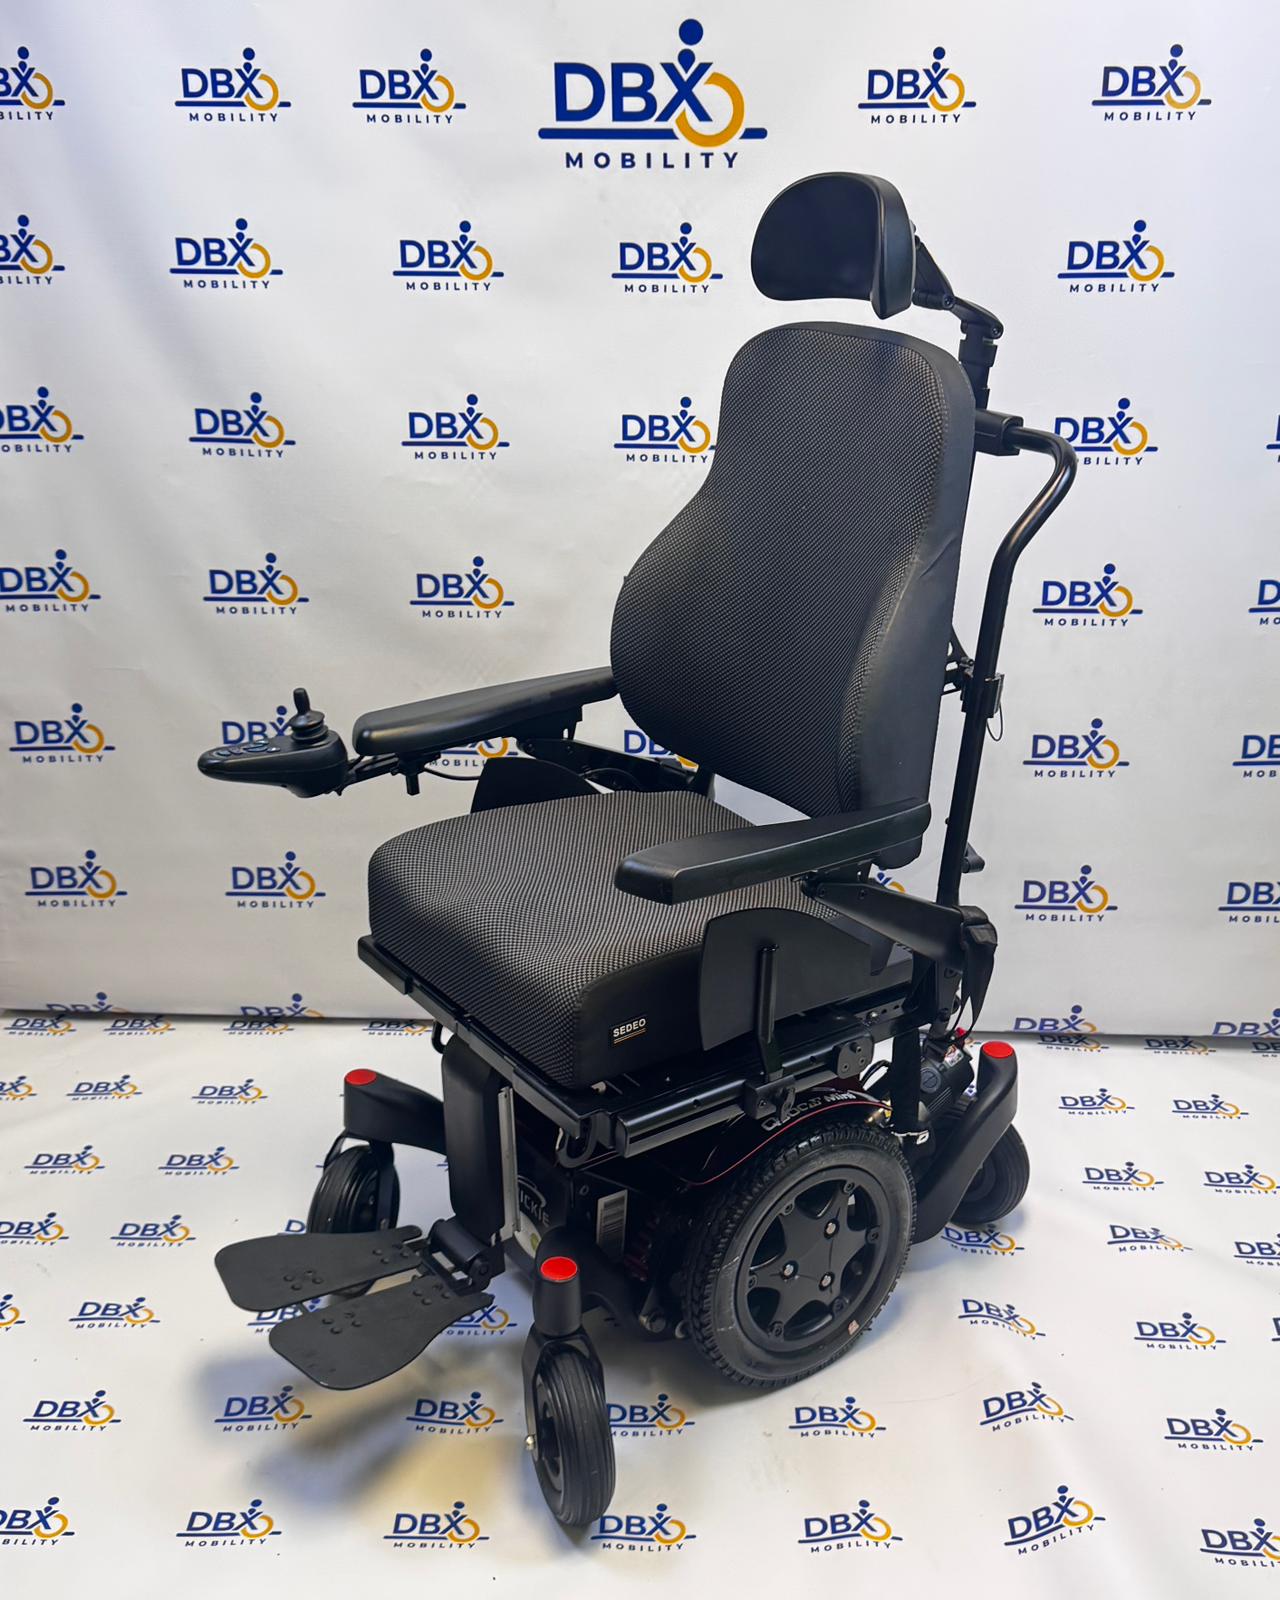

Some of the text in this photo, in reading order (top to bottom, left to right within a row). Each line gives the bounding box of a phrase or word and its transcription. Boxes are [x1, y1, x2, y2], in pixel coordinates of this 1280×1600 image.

[181, 68, 262, 98] DBX
[359, 69, 437, 99] DBX
[867, 69, 950, 99] DBX
[1101, 66, 1186, 96] DBX
[554, 62, 713, 122] DBX
[189, 112, 278, 122] MOBILITY
[366, 114, 453, 124] MOBILITY
[870, 113, 961, 124] MOBILITY
[1104, 111, 1196, 121] MOBILITY
[565, 152, 738, 169] MOBILITY
[175, 237, 255, 266] DBX
[400, 240, 477, 268] DBX
[620, 243, 697, 270] DBX
[1068, 241, 1149, 270] DBX
[183, 279, 270, 289] MOBILITY
[406, 282, 491, 291] MOBILITY
[624, 285, 709, 294] MOBILITY
[1070, 283, 1159, 293] MOBILITY
[195, 408, 272, 436] DBX
[408, 411, 484, 439] DBX
[621, 415, 696, 441] DBX
[1054, 417, 1133, 444] DBX
[1, 444, 72, 453] OBILITY
[202, 447, 284, 458] MOBILITY
[414, 451, 497, 460] MOBILITY
[626, 453, 708, 463] MOBILITY
[1083, 456, 1143, 466] BILITY
[0, 568, 73, 593] DBX
[209, 570, 283, 595] DBX
[416, 573, 490, 599] DBX
[1041, 580, 1118, 607] DBX
[5, 604, 89, 613] MOBILITY
[215, 606, 297, 615] MOBILITY
[422, 610, 502, 619] MOBILITY
[1044, 618, 1129, 627] MOBILITY
[15, 721, 88, 745] DBX
[1031, 735, 1106, 759] DBX
[22, 754, 104, 764] MOBILITY
[1034, 769, 1116, 778] MOBILITY
[30, 867, 103, 890] DBX
[231, 867, 304, 890] DBX
[1022, 880, 1095, 906] DBX
[37, 899, 116, 908] MOBILITY
[236, 900, 315, 909] MOBILITY
[1025, 913, 1105, 922] MOBILITY
[11, 1017, 65, 1028] DBX
[111, 1017, 165, 1029] DBX
[613, 1018, 646, 1037] SEDEO
[1014, 1017, 1084, 1032] DBX
[74, 1082, 129, 1093] DBX
[199, 1085, 253, 1097] DBX
[1060, 1095, 1115, 1107] DBX
[1173, 1099, 1228, 1111] DBX
[33, 1153, 91, 1166] DBX
[166, 1154, 225, 1167] DBX
[1084, 1167, 1142, 1182] DBX
[1204, 1171, 1265, 1185] DBX
[520, 1190, 551, 1228] ICKIE
[121, 1222, 184, 1237] DBX
[944, 1226, 1003, 1245] DBX
[0, 1238, 56, 1246] OBILITY
[79, 1301, 145, 1318] DBX
[962, 1299, 1021, 1325] DBX
[1136, 1321, 1200, 1339] DBX
[33, 1401, 106, 1418] DBX
[225, 1396, 294, 1417] DBX
[415, 1399, 482, 1420] DBX
[983, 1390, 1053, 1418] DBX
[607, 1403, 672, 1423] DBX
[795, 1405, 862, 1425] DBX
[30, 1424, 107, 1432] MOBILITY
[222, 1422, 299, 1432] MOBILITY
[415, 1424, 490, 1434] MOBILITY
[992, 1411, 1065, 1432] MOBILITY
[1166, 1417, 1237, 1438] DBX
[800, 1428, 875, 1438] MOBILITY
[1177, 1442, 1254, 1451] MOBILITY
[186, 1511, 265, 1531] DBX
[393, 1513, 468, 1535] DBX
[601, 1514, 671, 1536] DBX
[804, 1511, 876, 1538] DBX
[1008, 1496, 1079, 1539] DBX
[1, 1538, 59, 1546] BILITY
[184, 1538, 266, 1547] MOBILITY
[602, 1542, 685, 1551] MOBILITY
[810, 1540, 891, 1553] MOBILITY
[1018, 1523, 1095, 1555] MOBILITY
[1201, 1529, 1278, 1552] DBX
[1214, 1557, 1280, 1568] MOBILI
